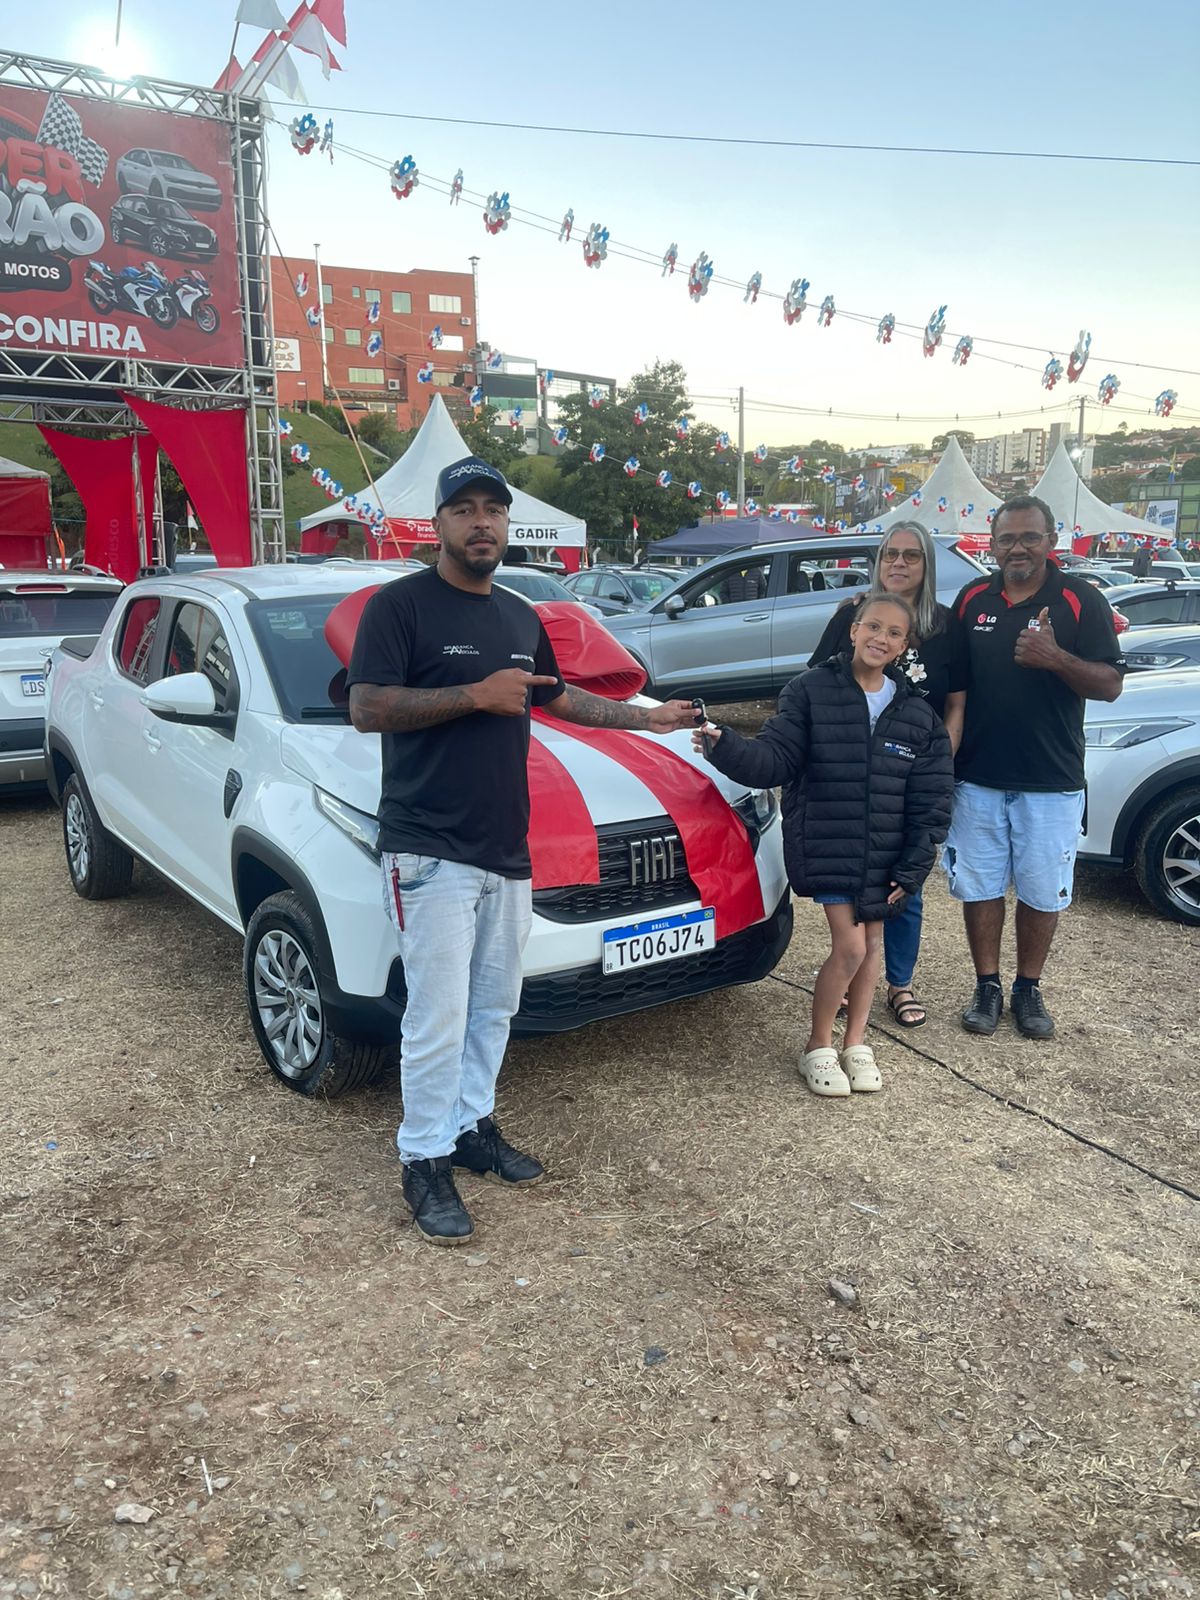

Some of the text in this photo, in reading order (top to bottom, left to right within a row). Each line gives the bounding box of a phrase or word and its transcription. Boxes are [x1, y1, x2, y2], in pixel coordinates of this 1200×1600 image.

[0, 137, 84, 206] ER
[4, 262, 60, 279] MOTOS
[515, 528, 558, 540] GADIR
[630, 834, 678, 886] FIAT
[651, 921, 671, 931] BRASIL
